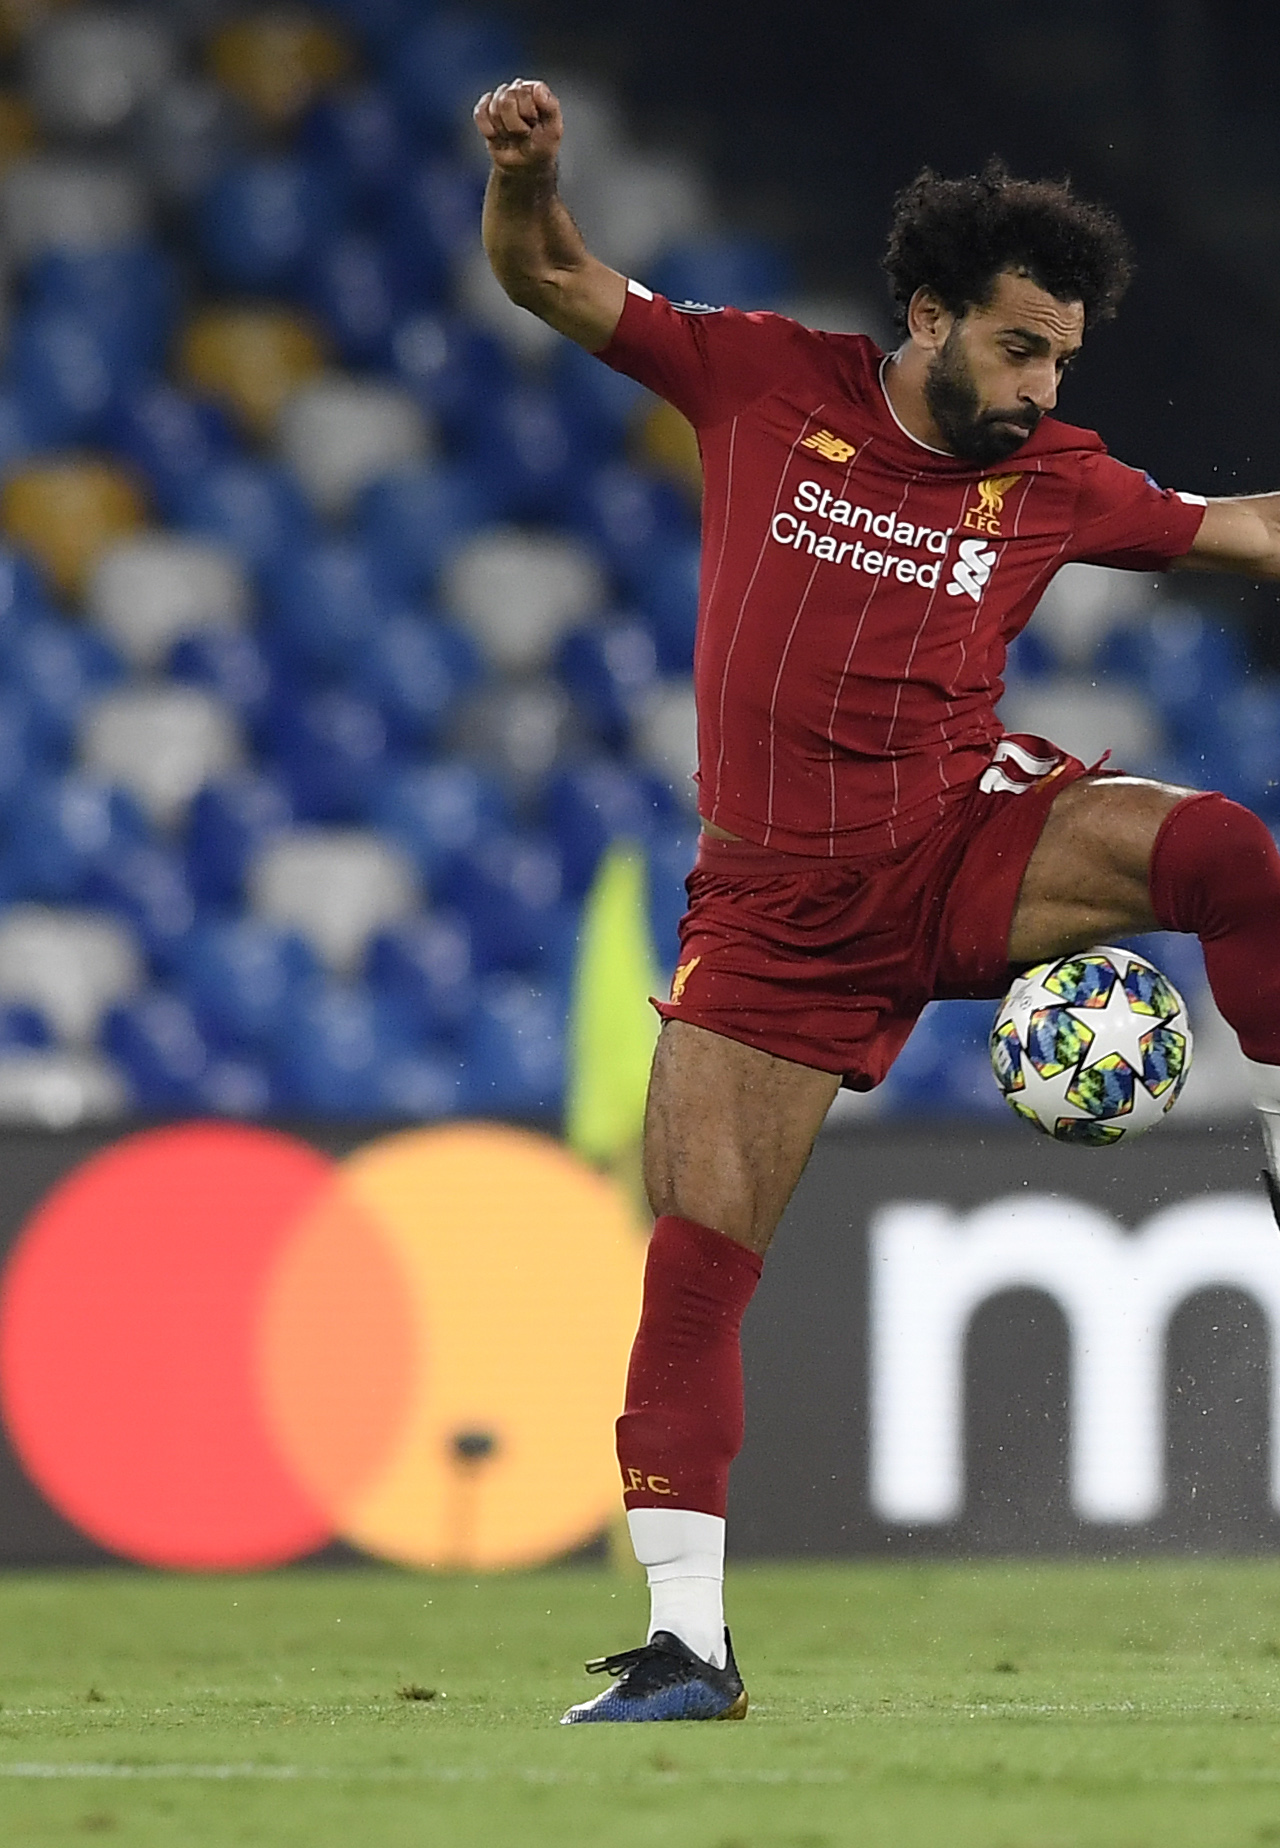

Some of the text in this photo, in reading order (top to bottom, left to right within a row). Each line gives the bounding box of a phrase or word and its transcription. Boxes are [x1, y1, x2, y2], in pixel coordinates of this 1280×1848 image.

[771, 512, 942, 589] Chartered
[794, 481, 952, 554] Standard
[979, 740, 1060, 794] 11
